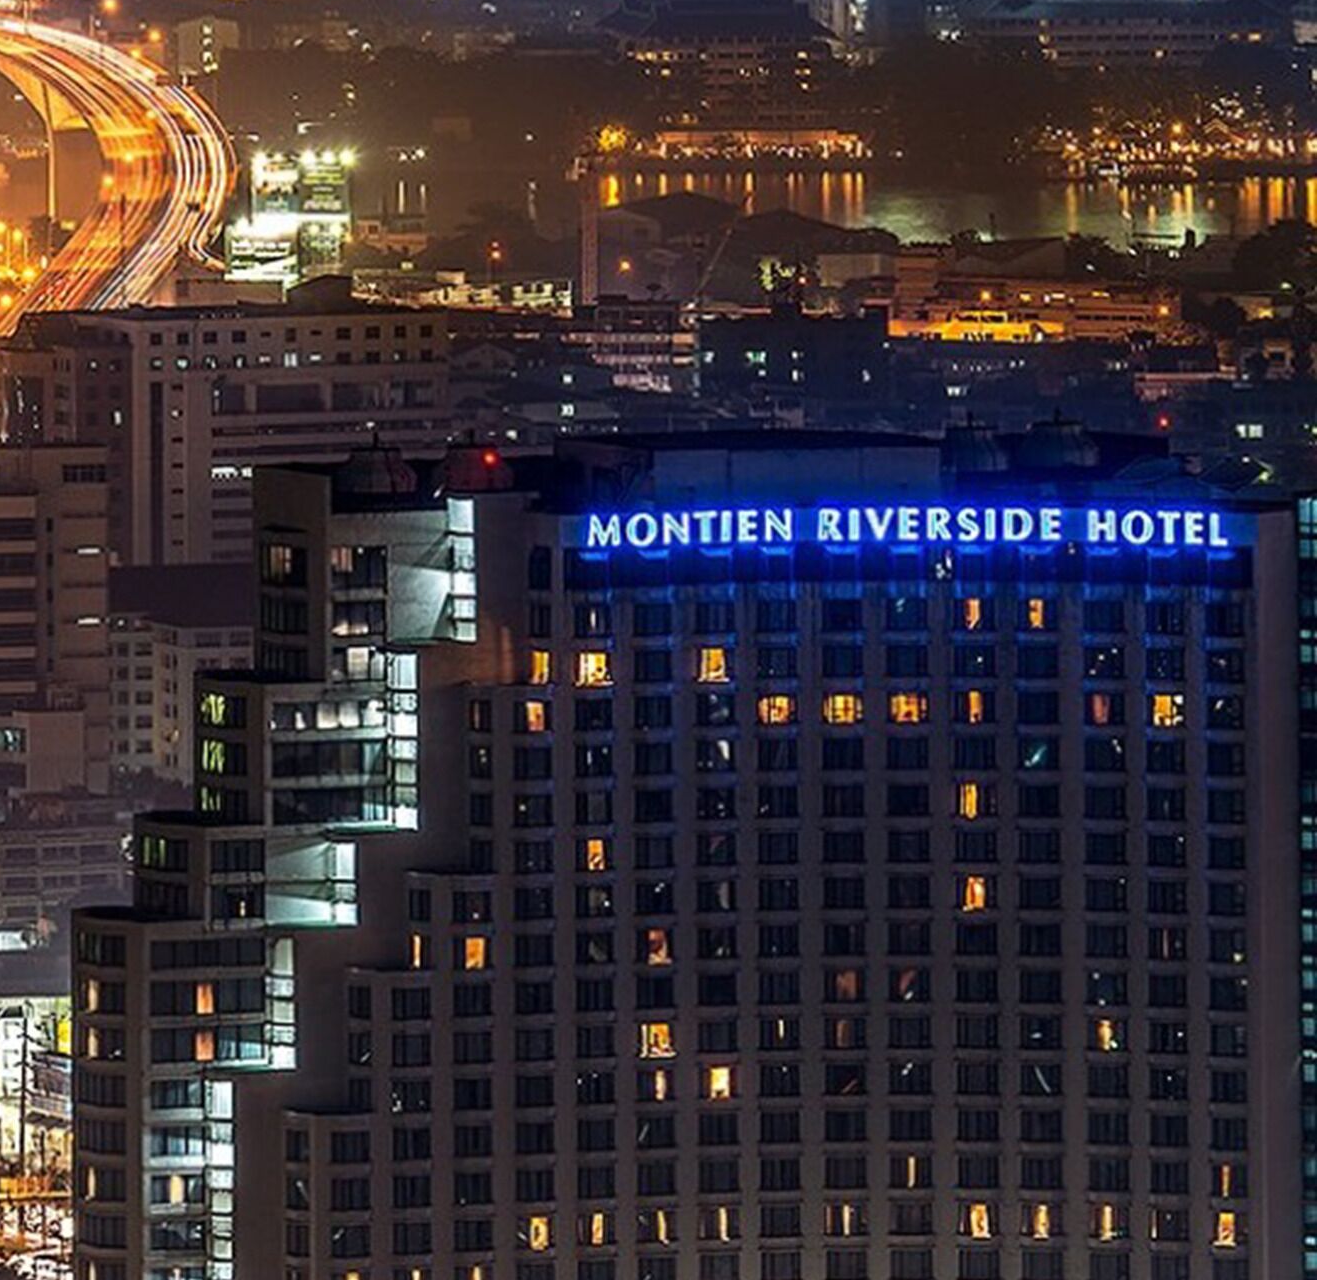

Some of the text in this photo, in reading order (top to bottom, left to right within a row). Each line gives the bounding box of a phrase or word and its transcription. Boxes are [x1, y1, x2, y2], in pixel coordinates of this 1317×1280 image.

[586, 507, 1228, 547] MONTIEN RIVERSIDE HOTEL
